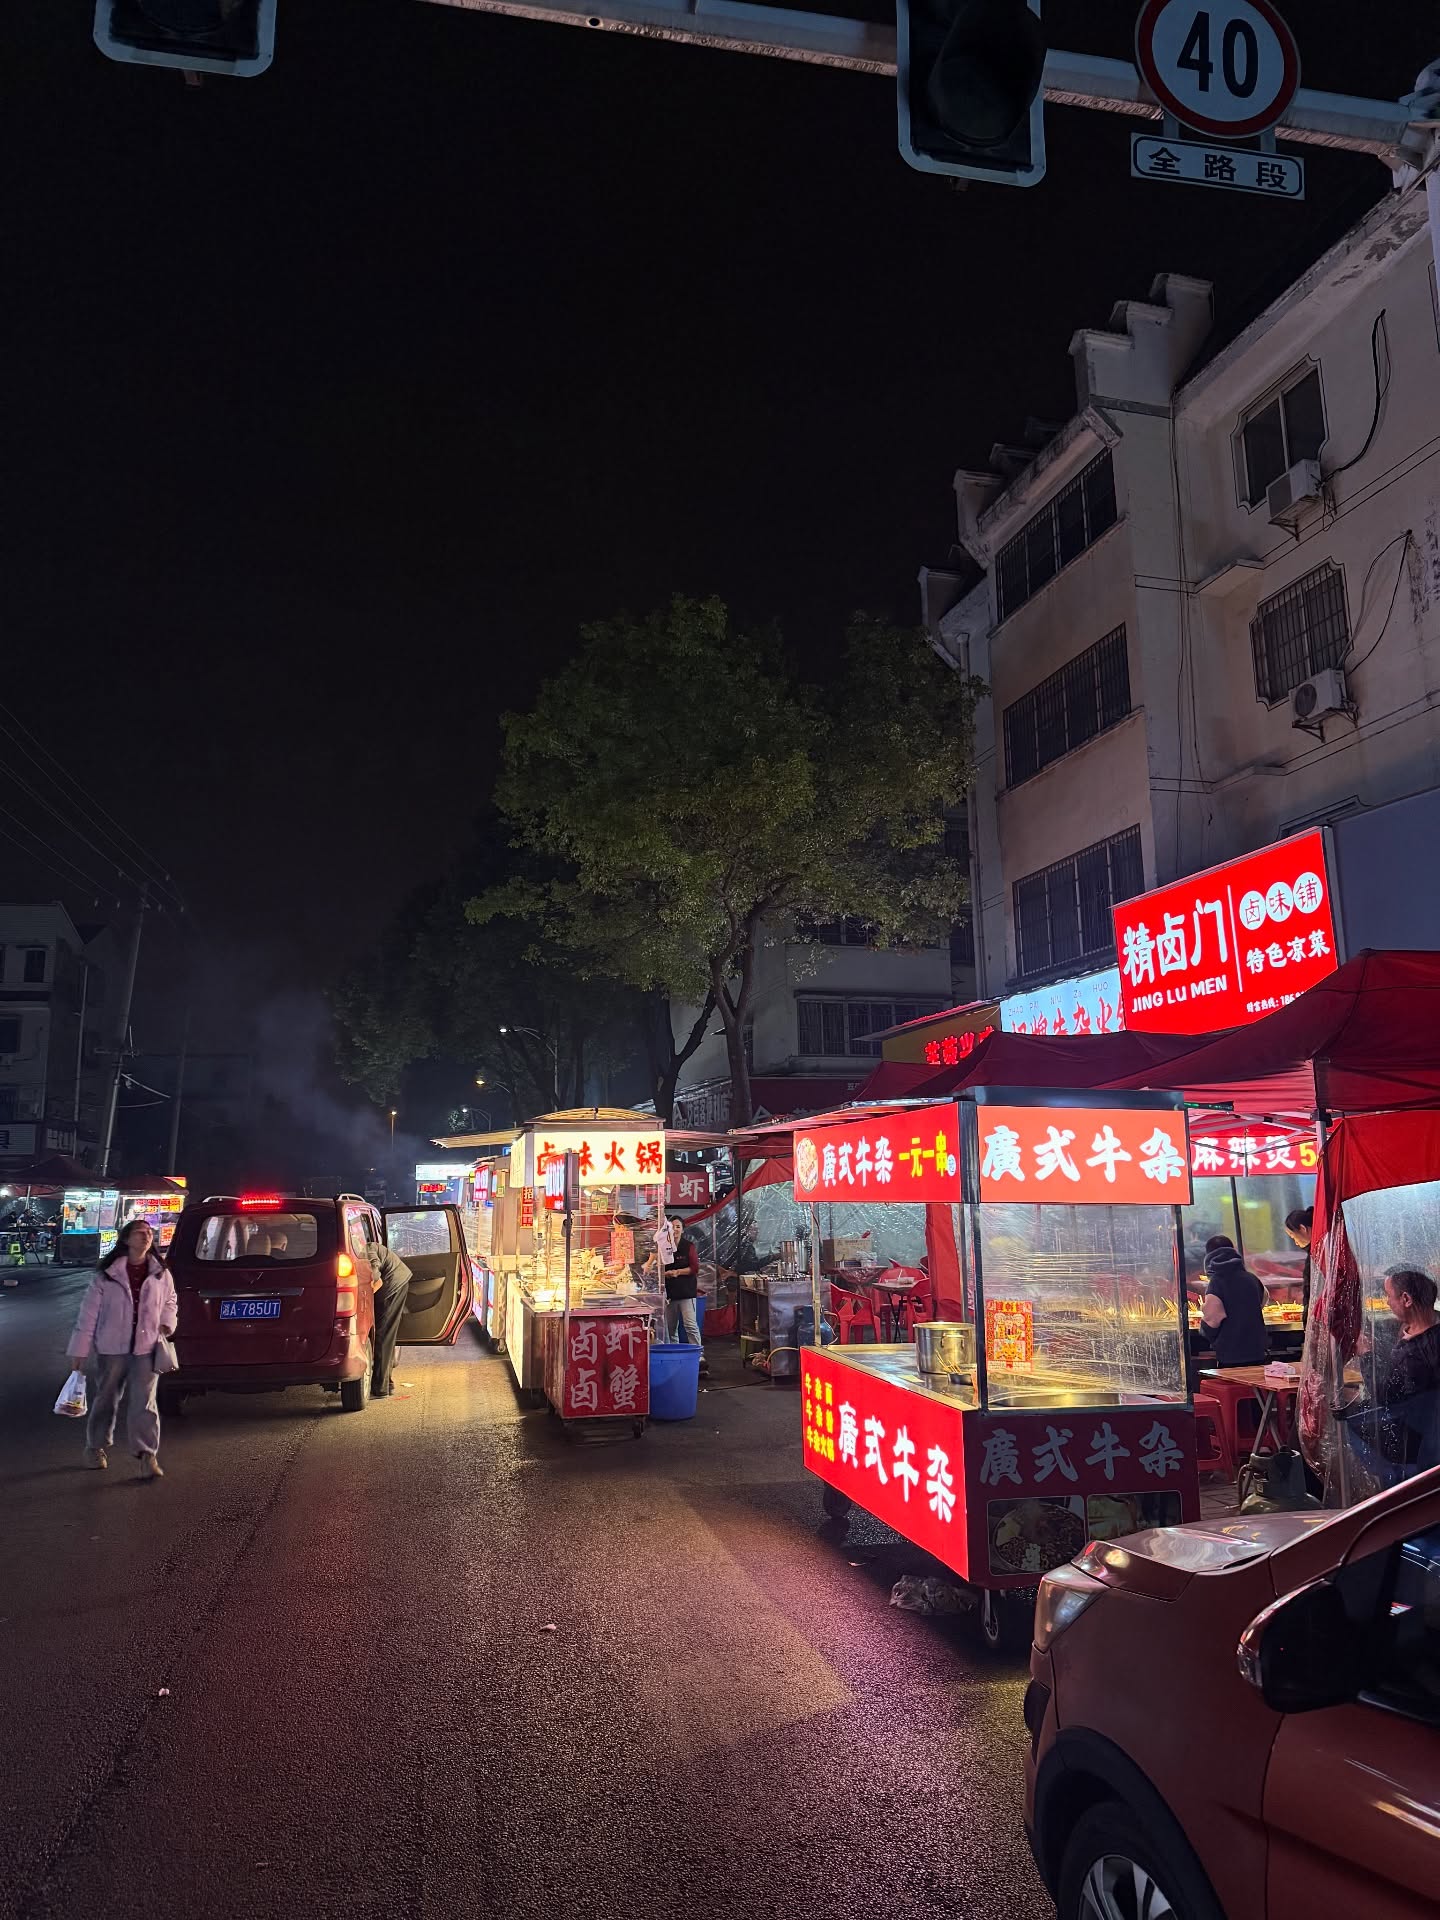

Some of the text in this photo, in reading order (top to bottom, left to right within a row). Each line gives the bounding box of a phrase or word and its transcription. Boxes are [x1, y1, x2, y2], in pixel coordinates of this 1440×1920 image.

[1177, 11, 1258, 98] 40
[1148, 147, 1287, 190] 全路段
[1244, 878, 1318, 925] 卤味铺
[1123, 899, 1228, 987] 精卤门
[1246, 929, 1330, 974] 特色凉菜
[1050, 995, 1062, 1005] NIU
[1093, 981, 1108, 993] HUO
[1132, 974, 1227, 1013] JING LU MEN
[821, 1135, 893, 1188] 廣式牛杂
[898, 1130, 948, 1178] 一元一串
[982, 1124, 1186, 1185] 廣式牛杂
[1192, 1135, 1317, 1171] 麻辣烫 5
[571, 1320, 642, 1365] 卤虾
[571, 1363, 641, 1412] 卤蟹
[838, 1400, 957, 1524] 廣式牛杂
[979, 1420, 1185, 1486] 廣式牛杂
